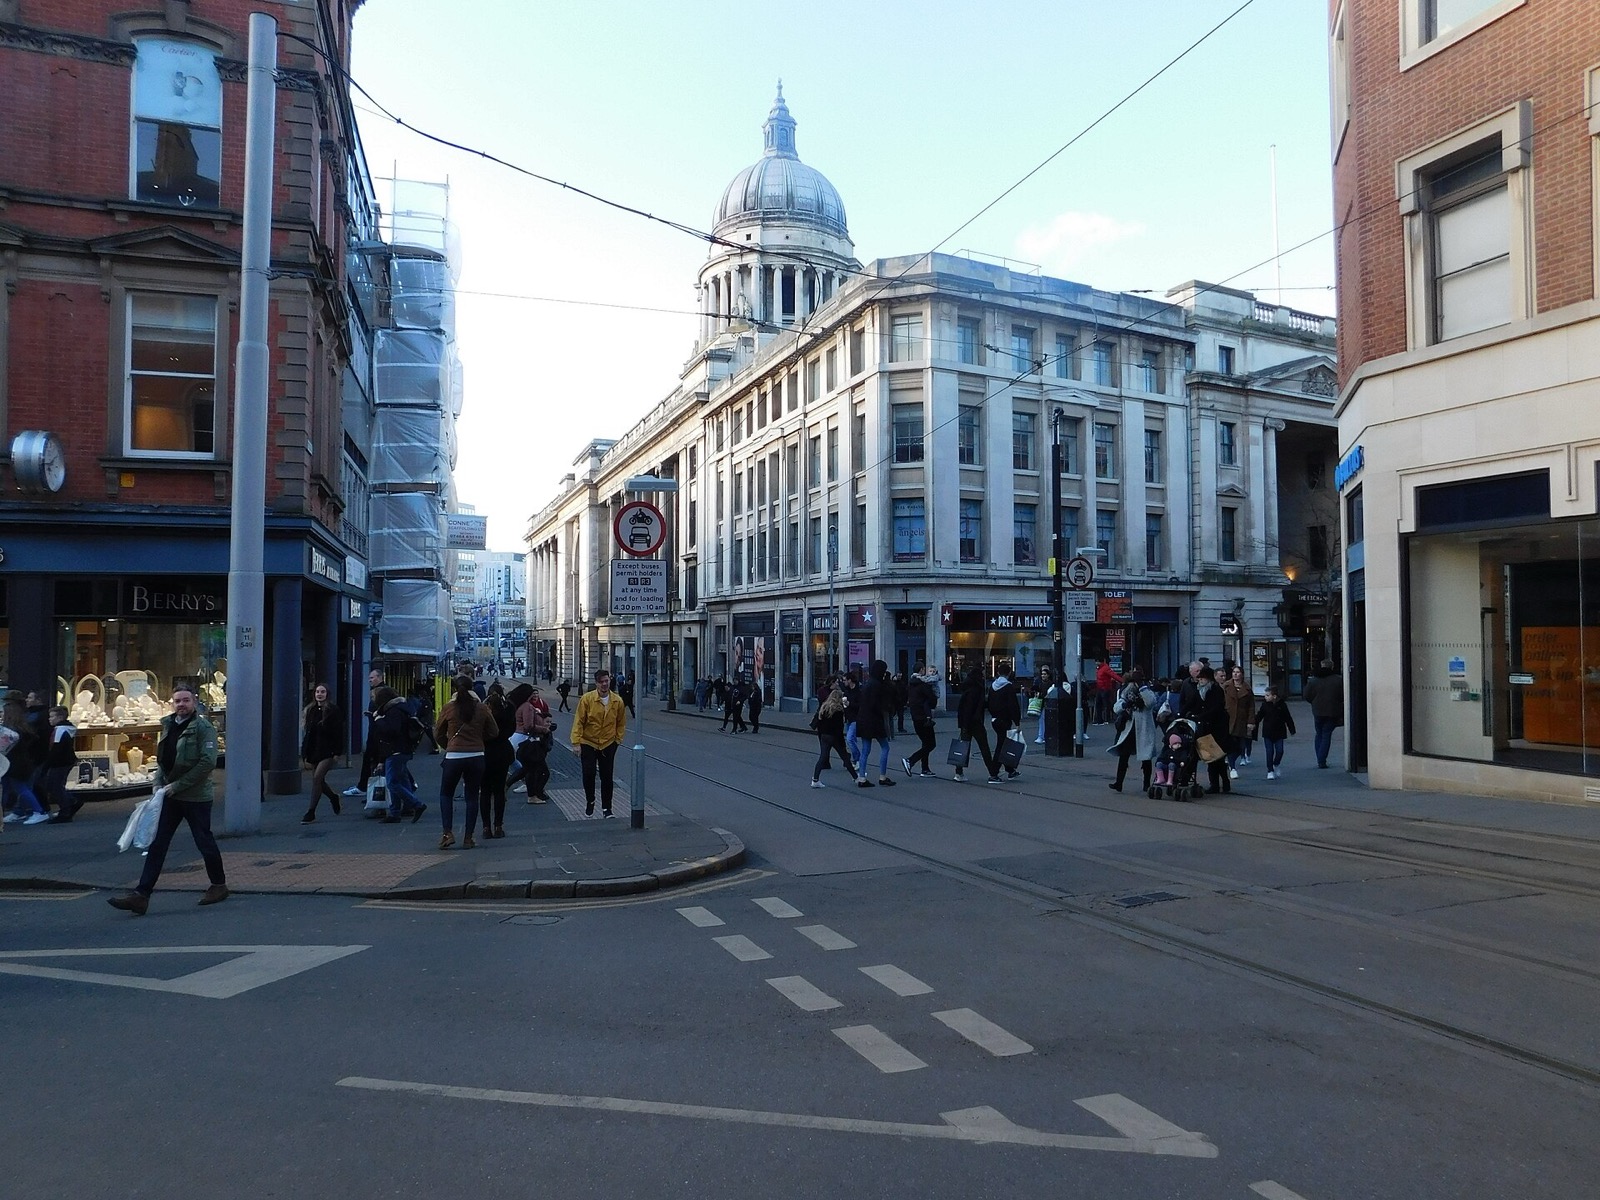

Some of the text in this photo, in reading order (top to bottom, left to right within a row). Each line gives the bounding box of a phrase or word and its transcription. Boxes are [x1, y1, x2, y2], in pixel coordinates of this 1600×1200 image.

[162, 46, 197, 57] Cartier
[899, 528, 926, 538] angels
[132, 586, 216, 611] BERRY'S
[998, 616, 1014, 628] PRET
[1017, 616, 1022, 627] A
